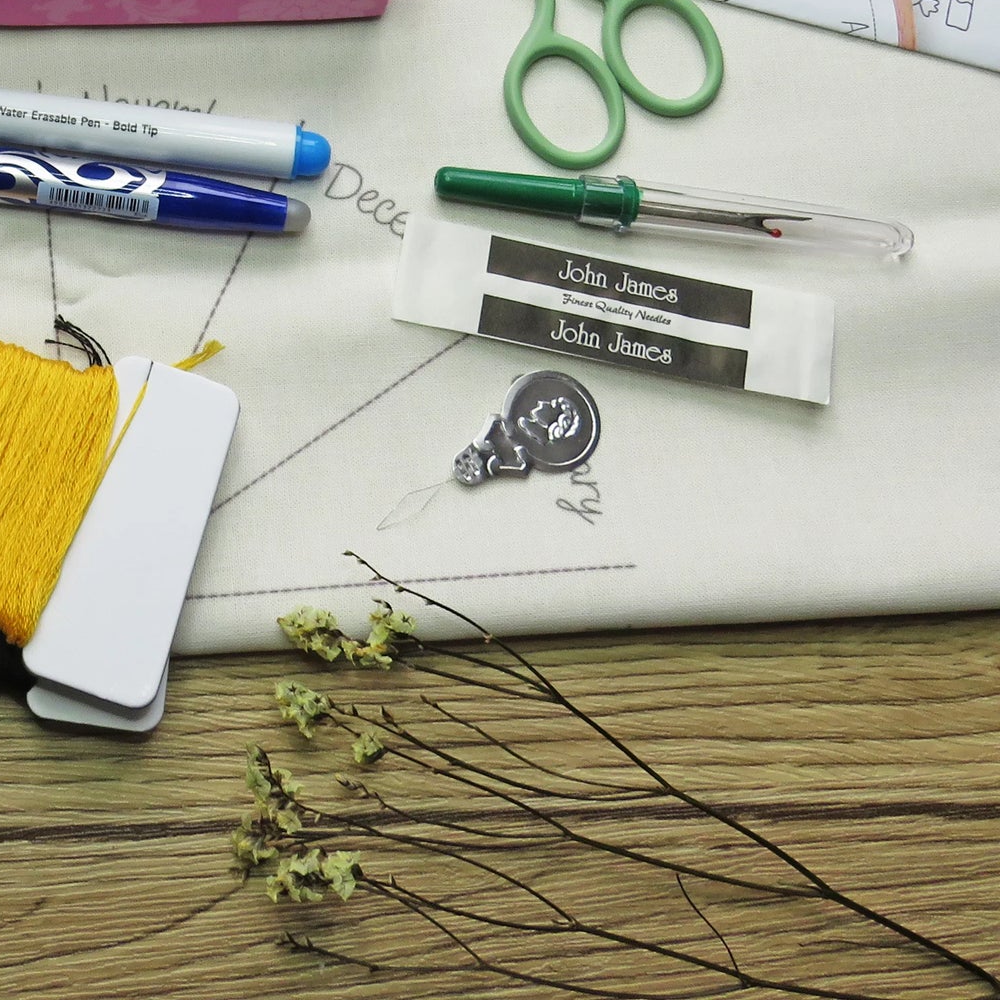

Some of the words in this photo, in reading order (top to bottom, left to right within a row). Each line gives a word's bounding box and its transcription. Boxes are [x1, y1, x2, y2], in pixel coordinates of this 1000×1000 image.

[31, 110, 76, 126] Erasable
[80, 116, 101, 129] Pen
[112, 120, 137, 133] Bold
[142, 124, 159, 137] Tip
[558, 259, 608, 289] John
[615, 271, 678, 303] James
[562, 293, 594, 308] Finest
[595, 300, 634, 320] Quality
[635, 309, 672, 325] Needles
[550, 319, 601, 349] John
[607, 331, 672, 364] James
